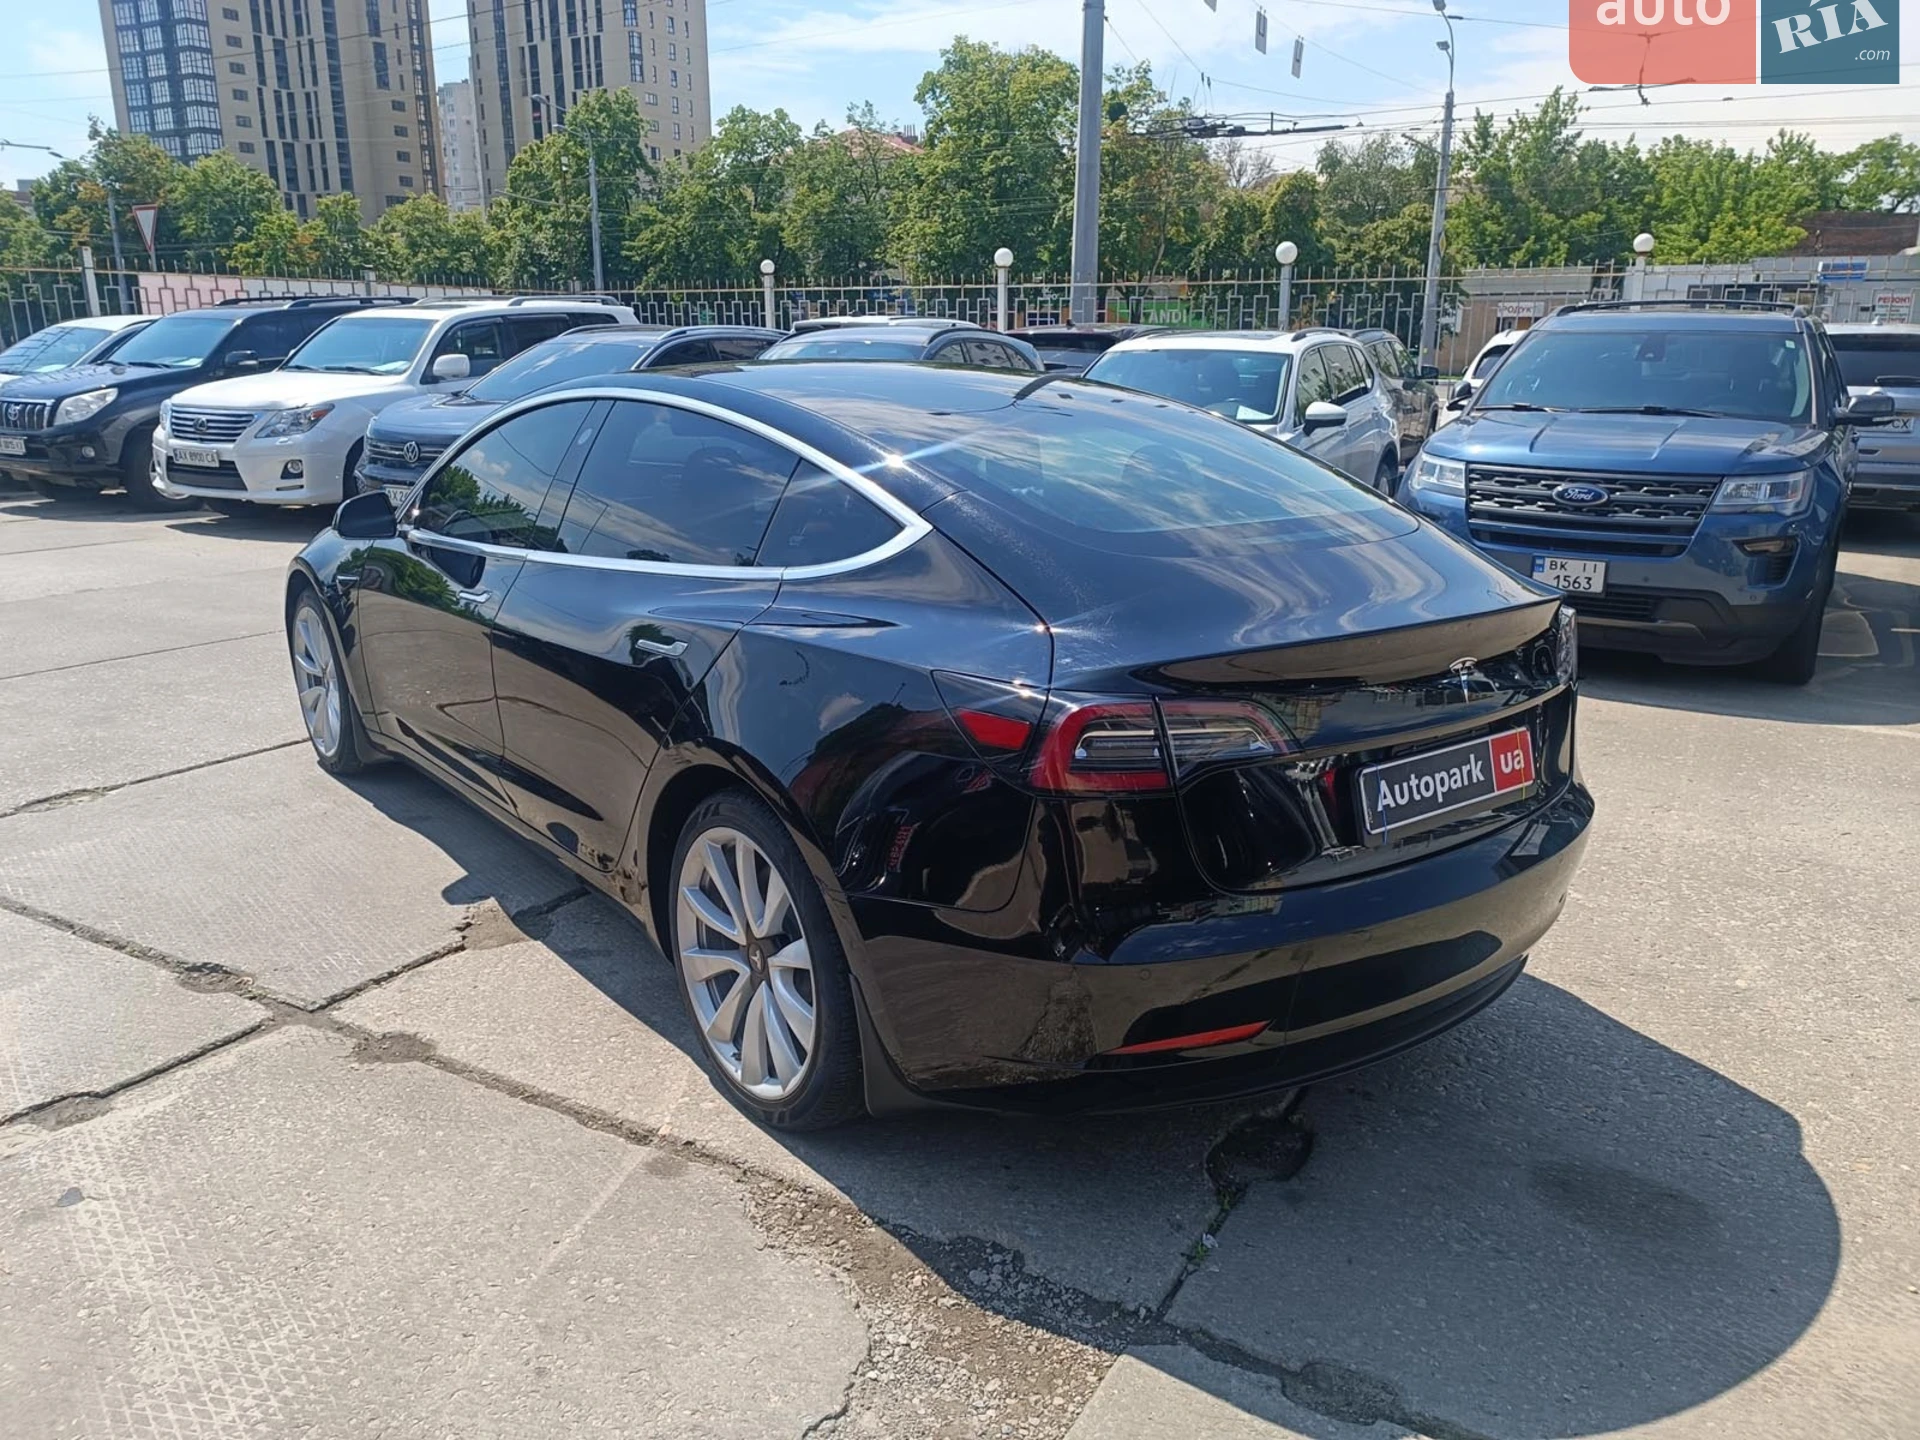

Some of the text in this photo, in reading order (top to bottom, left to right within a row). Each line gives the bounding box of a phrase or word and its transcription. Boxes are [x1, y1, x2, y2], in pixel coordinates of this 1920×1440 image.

[1141, 309, 1187, 324] ANDI
[1564, 487, 1594, 501] Ford
[1549, 560, 1568, 571] BK
[1553, 574, 1593, 590] 1563
[1377, 748, 1525, 812] Autopark ua
